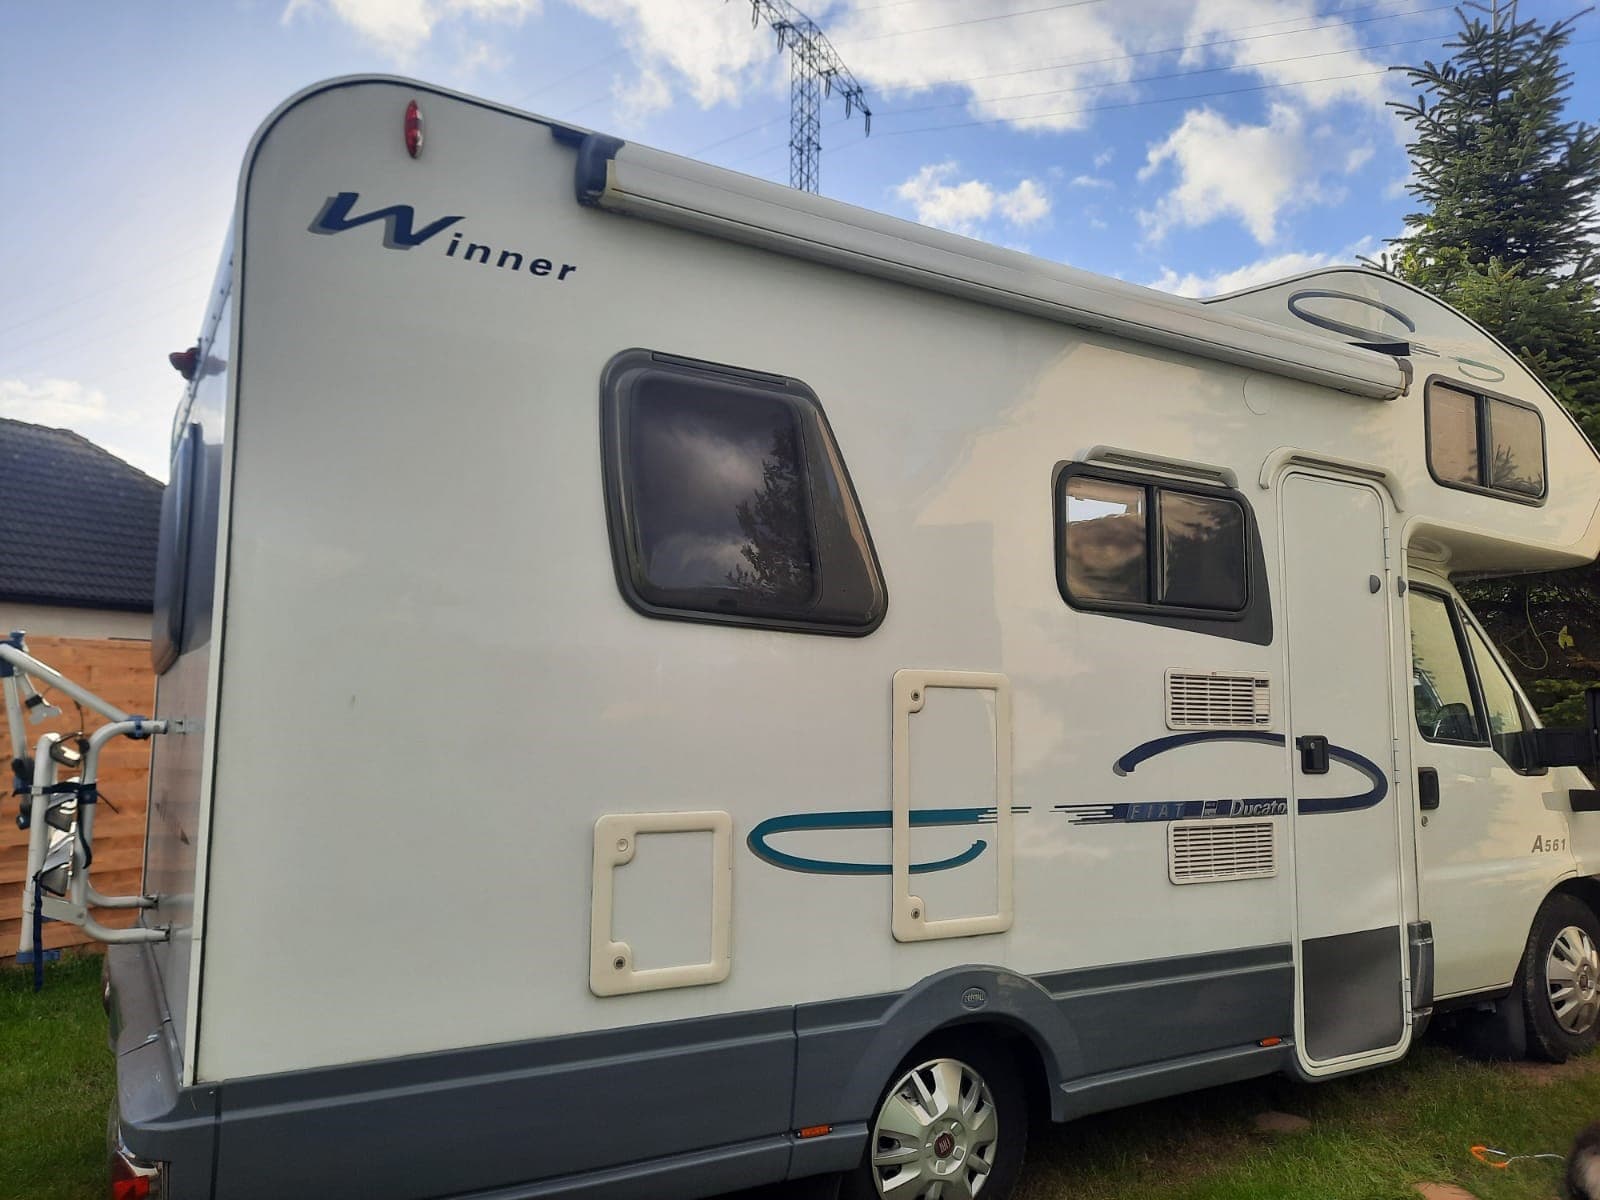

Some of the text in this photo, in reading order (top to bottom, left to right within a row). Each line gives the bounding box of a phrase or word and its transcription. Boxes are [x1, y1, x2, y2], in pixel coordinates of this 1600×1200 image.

[307, 192, 577, 281] Winner
[1128, 798, 1287, 820] FIAT Ducato
